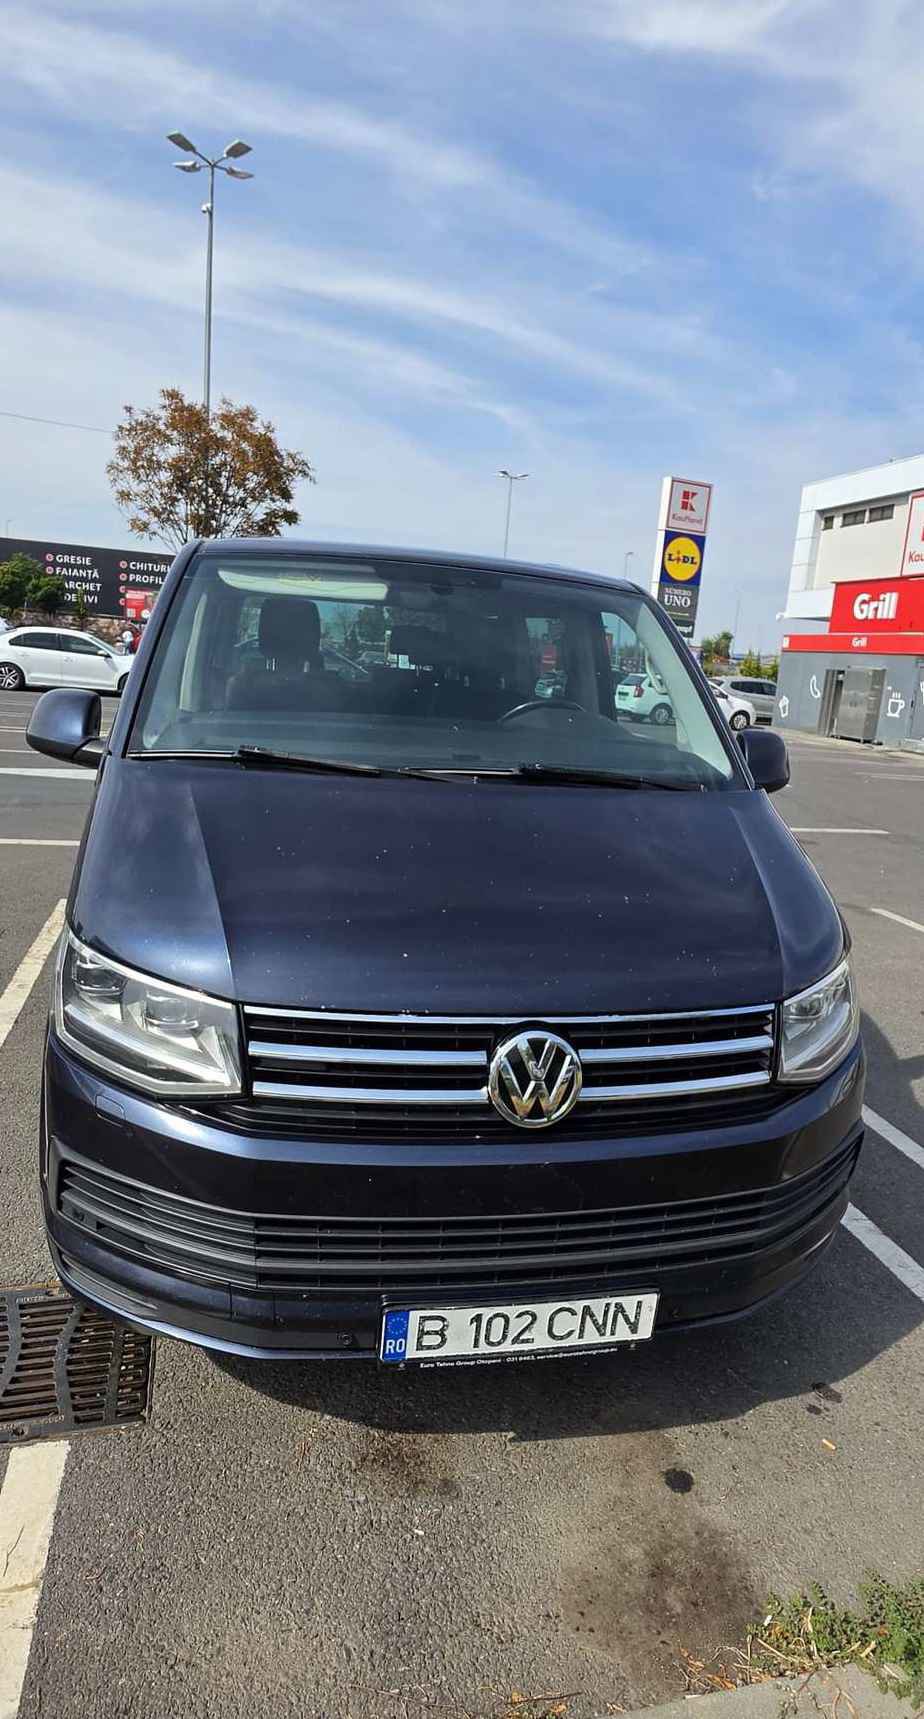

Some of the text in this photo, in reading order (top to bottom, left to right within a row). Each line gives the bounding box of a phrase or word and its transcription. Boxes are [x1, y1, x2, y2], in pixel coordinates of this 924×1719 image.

[55, 554, 92, 566] GRESIE
[664, 594, 691, 608] UNO
[853, 591, 899, 620] Grill
[851, 636, 868, 647] Grill
[416, 1300, 643, 1351] B 102 CNN
[385, 1338, 406, 1354] RO
